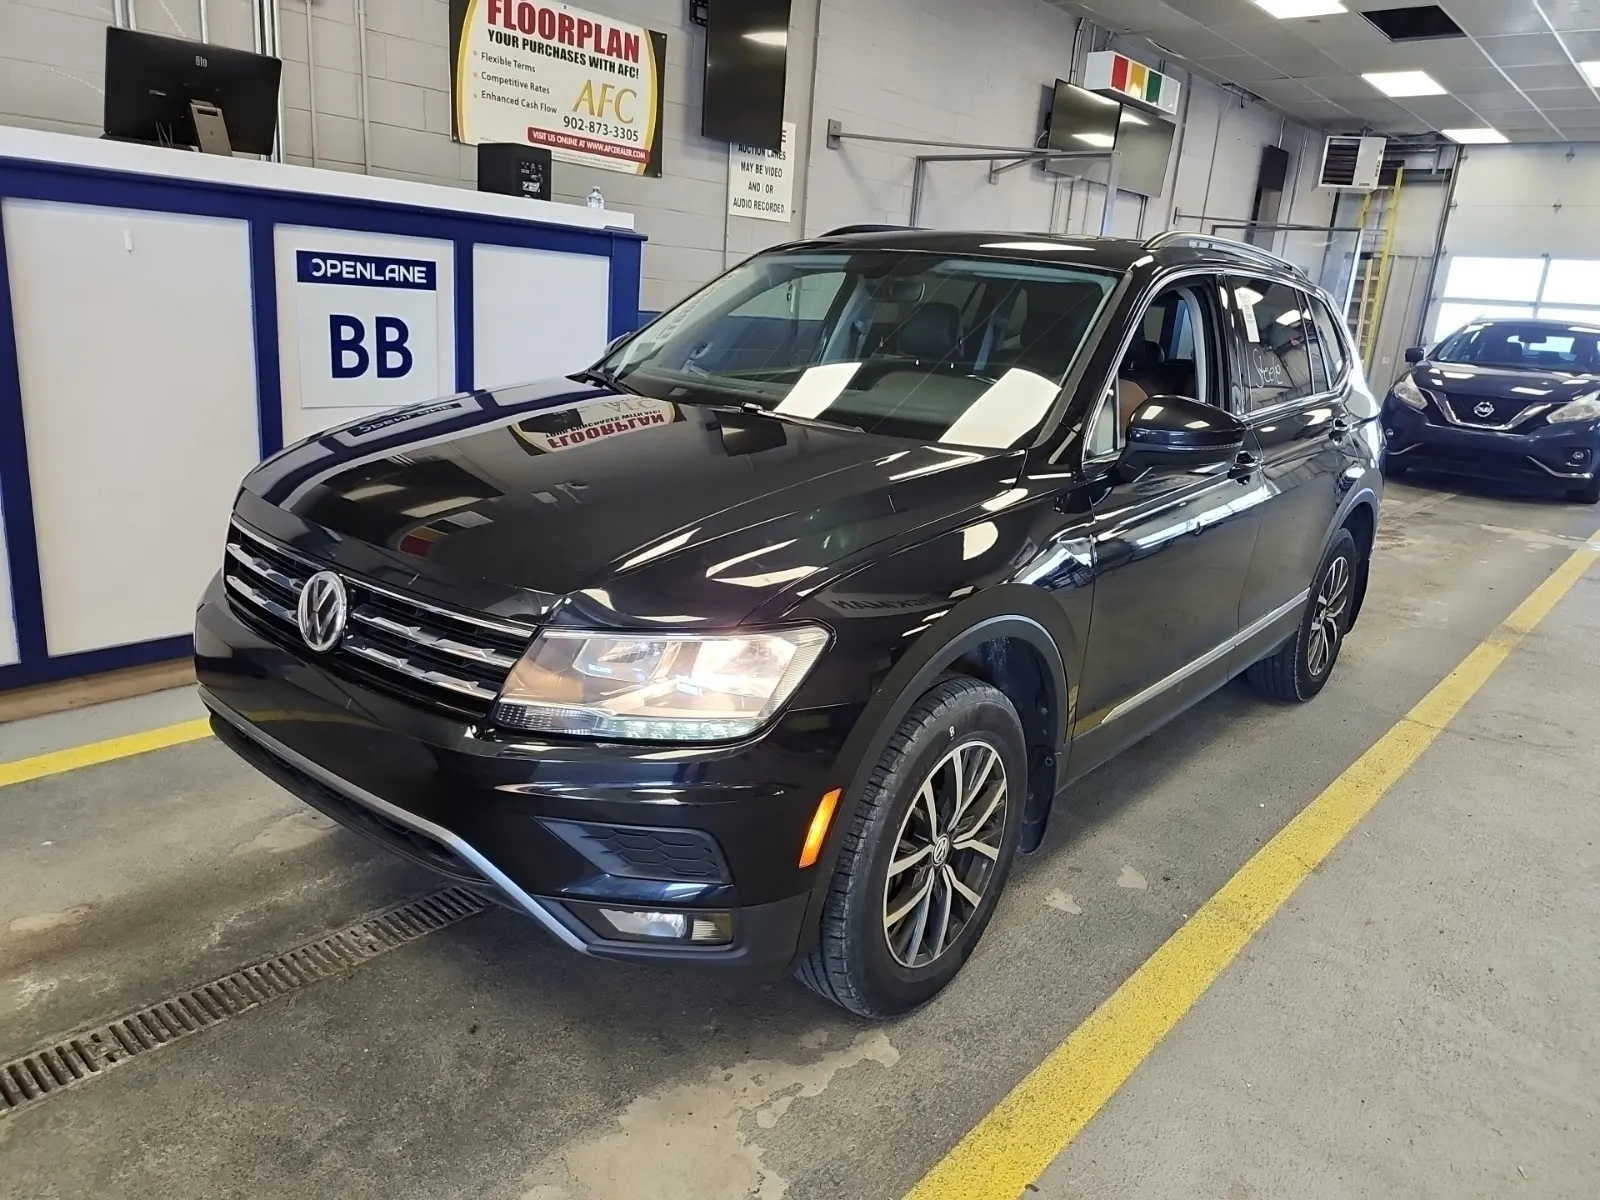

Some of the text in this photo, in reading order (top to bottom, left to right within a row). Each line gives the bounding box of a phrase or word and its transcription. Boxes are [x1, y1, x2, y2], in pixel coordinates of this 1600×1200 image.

[487, 0, 639, 63] FLOORPLAN
[481, 52, 536, 73] Flexible Terms
[487, 28, 639, 79] YOUR PURCHASES WITH AFC!
[481, 72, 550, 95] Competitive Rates
[481, 90, 558, 114] Enhanced Cash Flow
[572, 79, 638, 124] AFC
[563, 115, 639, 142] 902-873-3305
[532, 130, 646, 159] VISIT US ONLINE AT WWW.AFCDEALER.COM
[740, 161, 783, 178] MAY BE VIDEO
[748, 181, 761, 192] AND
[765, 184, 774, 194] OR
[733, 197, 786, 214] AUDIO RECORDED.
[309, 258, 427, 284] OPENLANE
[329, 314, 413, 379] BB
